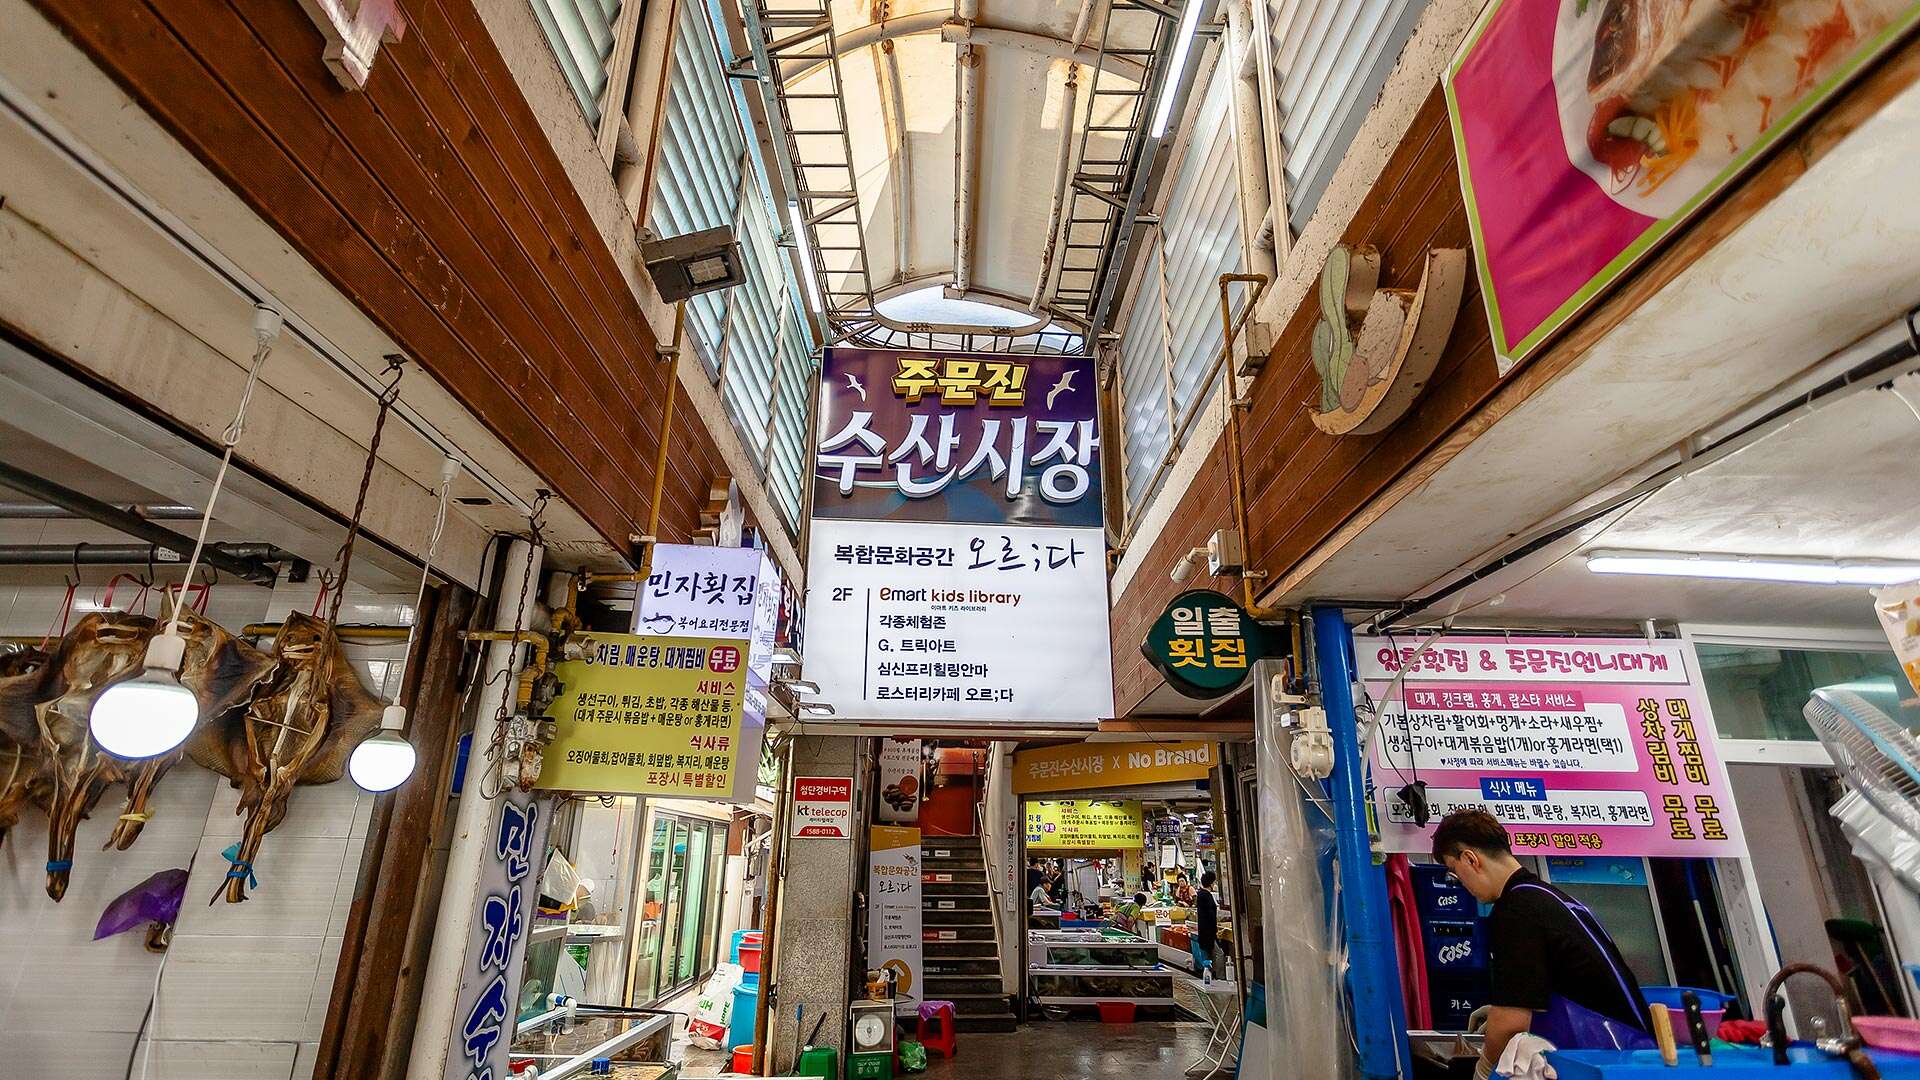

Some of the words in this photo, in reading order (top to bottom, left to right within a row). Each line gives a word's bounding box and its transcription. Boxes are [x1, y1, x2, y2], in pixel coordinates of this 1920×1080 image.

[892, 356, 1029, 406] 주문진
[816, 411, 1100, 504] 수산시장
[834, 543, 955, 567] 복합문화공간
[967, 535, 1085, 571] 오르;다
[648, 570, 756, 606] 민자횟집
[832, 587, 853, 601] 2F
[880, 587, 927, 602] emart
[931, 589, 965, 603] kids
[969, 590, 1021, 607] library
[677, 616, 750, 632] 복어요리전문점
[879, 615, 946, 629] 각종체험존
[1171, 606, 1241, 636] 일출
[878, 639, 894, 652] G.
[900, 639, 957, 653] 트릭아트
[1168, 638, 1247, 668] 횟집
[710, 649, 736, 670] 무료
[1480, 650, 1497, 671] &
[1505, 649, 1668, 674] 주문진언니대게
[878, 662, 988, 678] 심신프리힐링안마
[697, 680, 736, 696] 서비스
[876, 686, 960, 701] 로스터리카페
[965, 687, 1014, 702] 오르;다
[578, 692, 618, 707] 생선구이,
[645, 696, 667, 710] 초밥,
[670, 697, 688, 711] 각종
[691, 699, 719, 712] 해산물
[1414, 692, 1440, 708] 대게,
[1442, 692, 1478, 708] 킹크랩,
[1481, 693, 1506, 708] 홍게,
[1545, 694, 1576, 707] 서비스
[574, 708, 595, 723] (대게
[596, 709, 622, 724] 주문시
[624, 710, 649, 725] 볶음밥
[658, 712, 683, 727] 매운탕
[684, 716, 692, 725] or
[694, 713, 732, 729] 홍게라면)
[690, 735, 730, 751] 식사류
[704, 757, 729, 771] 매운탕
[1028, 756, 1104, 779] 주문진수산시장
[1128, 751, 1150, 768] No
[1155, 744, 1210, 767] Brand
[1447, 757, 1467, 768] 사정에
[1470, 757, 1484, 767] 따라
[1486, 758, 1527, 769] 서비스메뉴는
[1636, 698, 1678, 785] 상차림비
[1663, 794, 1696, 840] 무료
[1665, 698, 1709, 785] 대게찜비
[1694, 794, 1728, 840] 무료
[647, 772, 680, 787] 포장시
[683, 773, 726, 788] 특별할인
[800, 785, 848, 796] 첨단경비구역
[1489, 781, 1510, 797] 식사
[1514, 781, 1537, 797] 메뉴
[797, 805, 809, 816] kt
[811, 808, 848, 819] telecop
[1495, 804, 1529, 820] 회덮밥,
[1532, 804, 1567, 821] 매운탕,
[1570, 804, 1605, 821] 복지리,
[1608, 805, 1650, 821] 홍게라면
[1515, 832, 1549, 848] 포장시
[1552, 833, 1576, 848] 할인
[1578, 833, 1603, 849] 적용
[873, 864, 918, 877] 복합문화공간
[879, 880, 912, 893] 오르;다
[464, 801, 538, 1080] 민자수
[1438, 940, 1471, 964] Cass
[1451, 999, 1472, 1010] 카스
